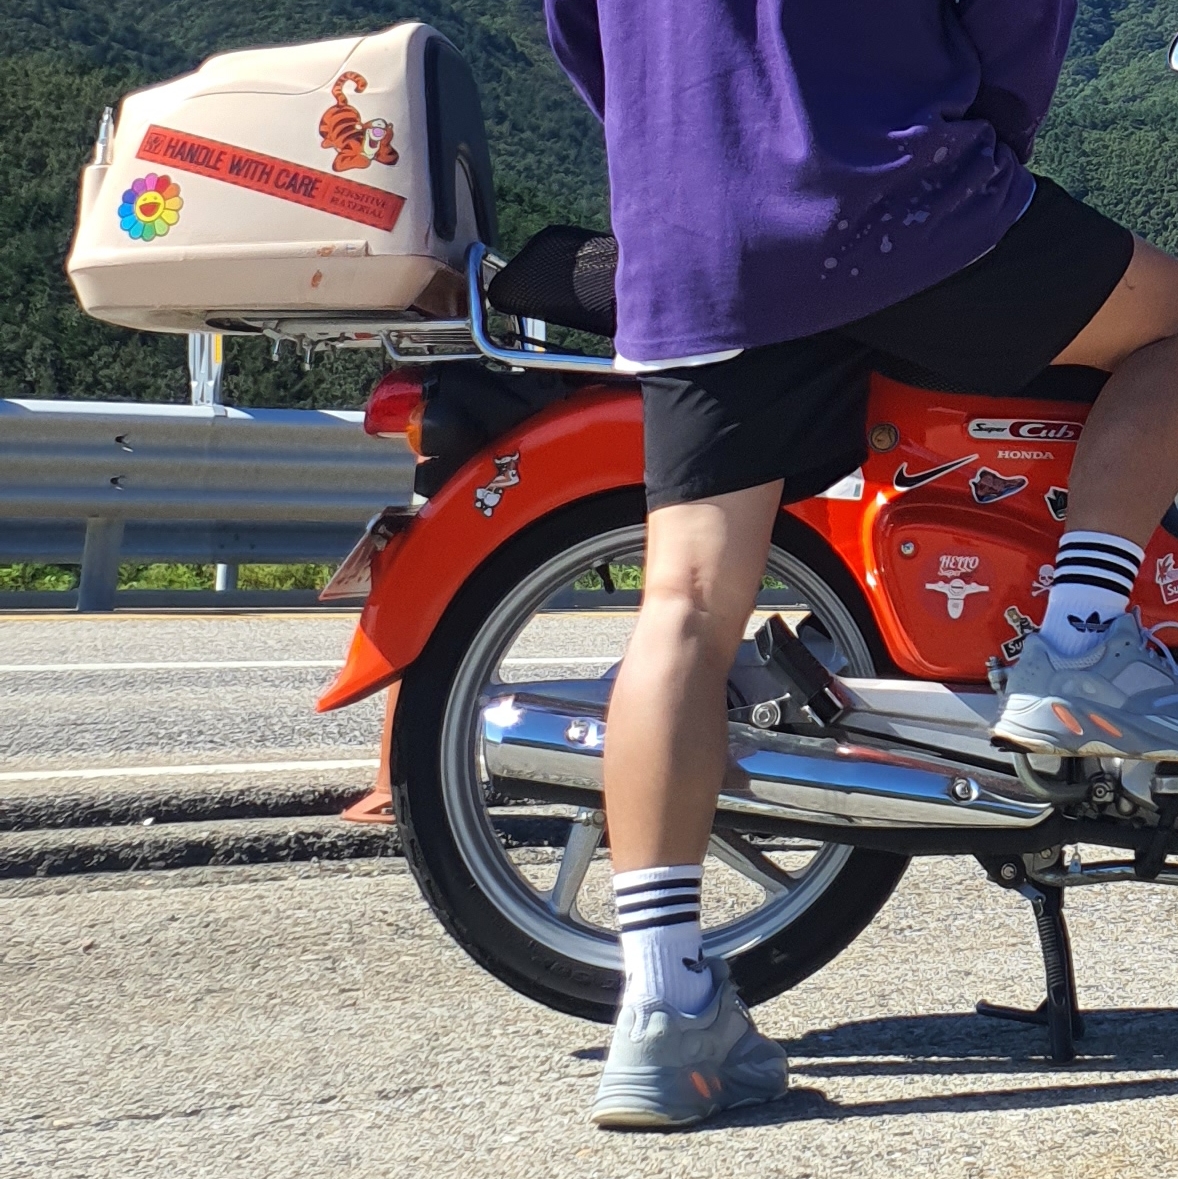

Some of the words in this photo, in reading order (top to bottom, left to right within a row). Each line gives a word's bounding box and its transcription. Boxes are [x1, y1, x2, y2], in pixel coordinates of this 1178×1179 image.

[163, 137, 227, 171] HANDLE
[228, 154, 274, 185] WITH
[274, 170, 323, 199] CARE
[972, 423, 1007, 433] Super
[1019, 423, 1074, 438] Cub
[997, 450, 1054, 460] HONDA
[939, 555, 979, 572] HELLO
